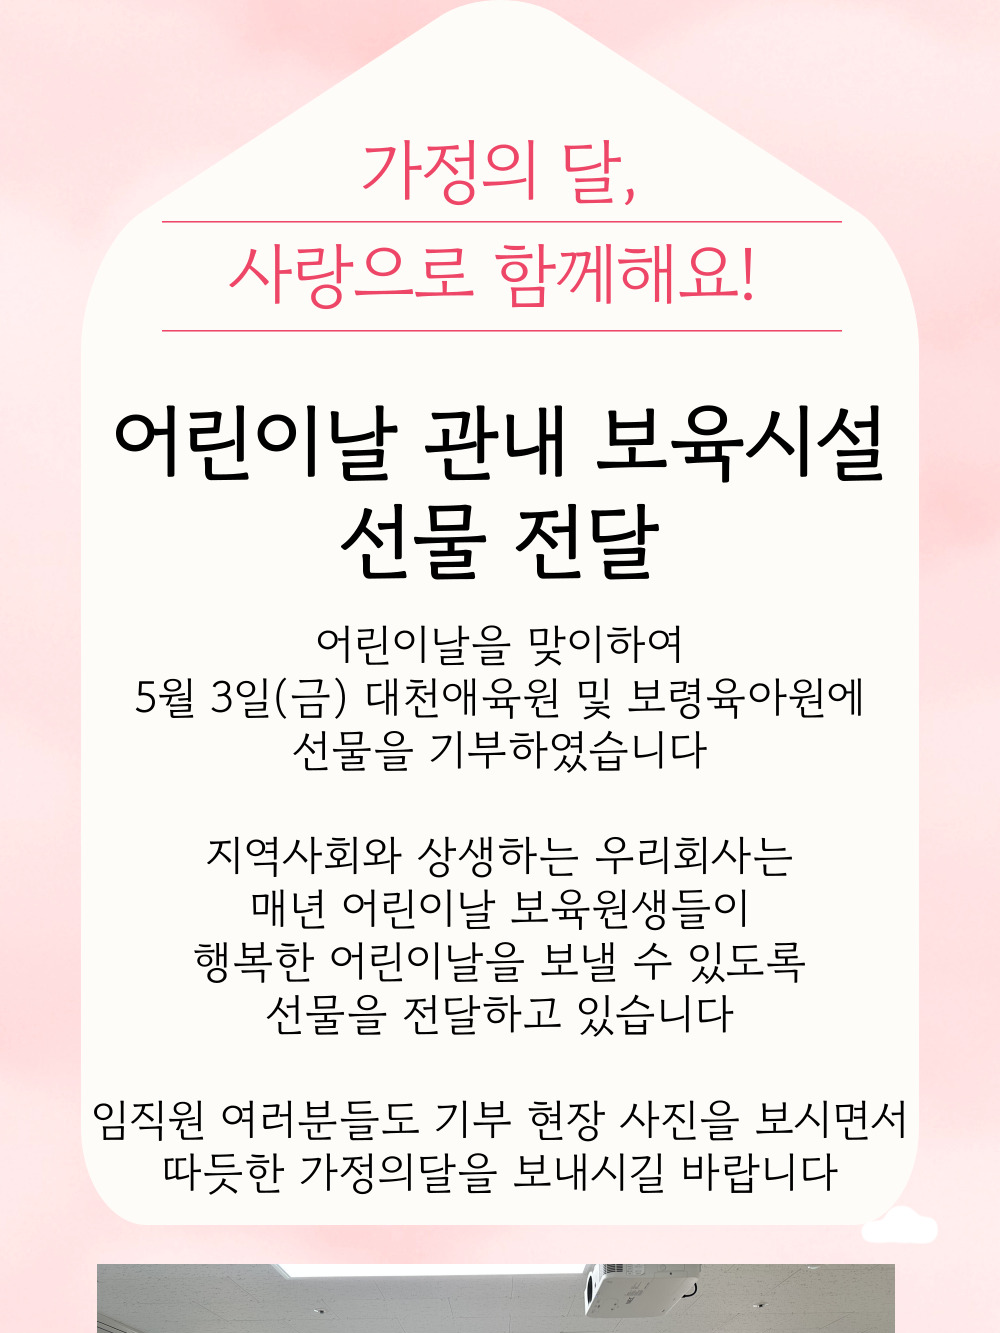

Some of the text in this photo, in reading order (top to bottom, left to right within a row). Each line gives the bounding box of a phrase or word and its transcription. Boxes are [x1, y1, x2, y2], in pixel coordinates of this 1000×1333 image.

[363, 140, 635, 206] 가정의 달,
[229, 243, 754, 309] 사랑으로 함께해요!
[116, 405, 882, 483] 어린이날 관내 보육시설
[341, 504, 659, 580] 선물 전달
[317, 625, 682, 666] 어린이날을 맞이하여
[136, 678, 862, 719] 5월 3일(금) 대천애육원 및 보령육아원에
[293, 731, 707, 773] 선물을 기부하였습니다
[207, 837, 792, 877] 지역사회와 상생하는 우리회사는
[252, 889, 746, 930] 매년 어린이날 보육원생들이
[195, 942, 805, 984] 행복한 어린이날을 보낼 수 있도록
[267, 995, 733, 1037] 선물을 전달하고 있습니다
[94, 1100, 905, 1141] 임직원 여러분들도 기부 현장 사진을 보시면서
[164, 1153, 838, 1195] 따듯한 가정의달을 보내시길 바랍니다
